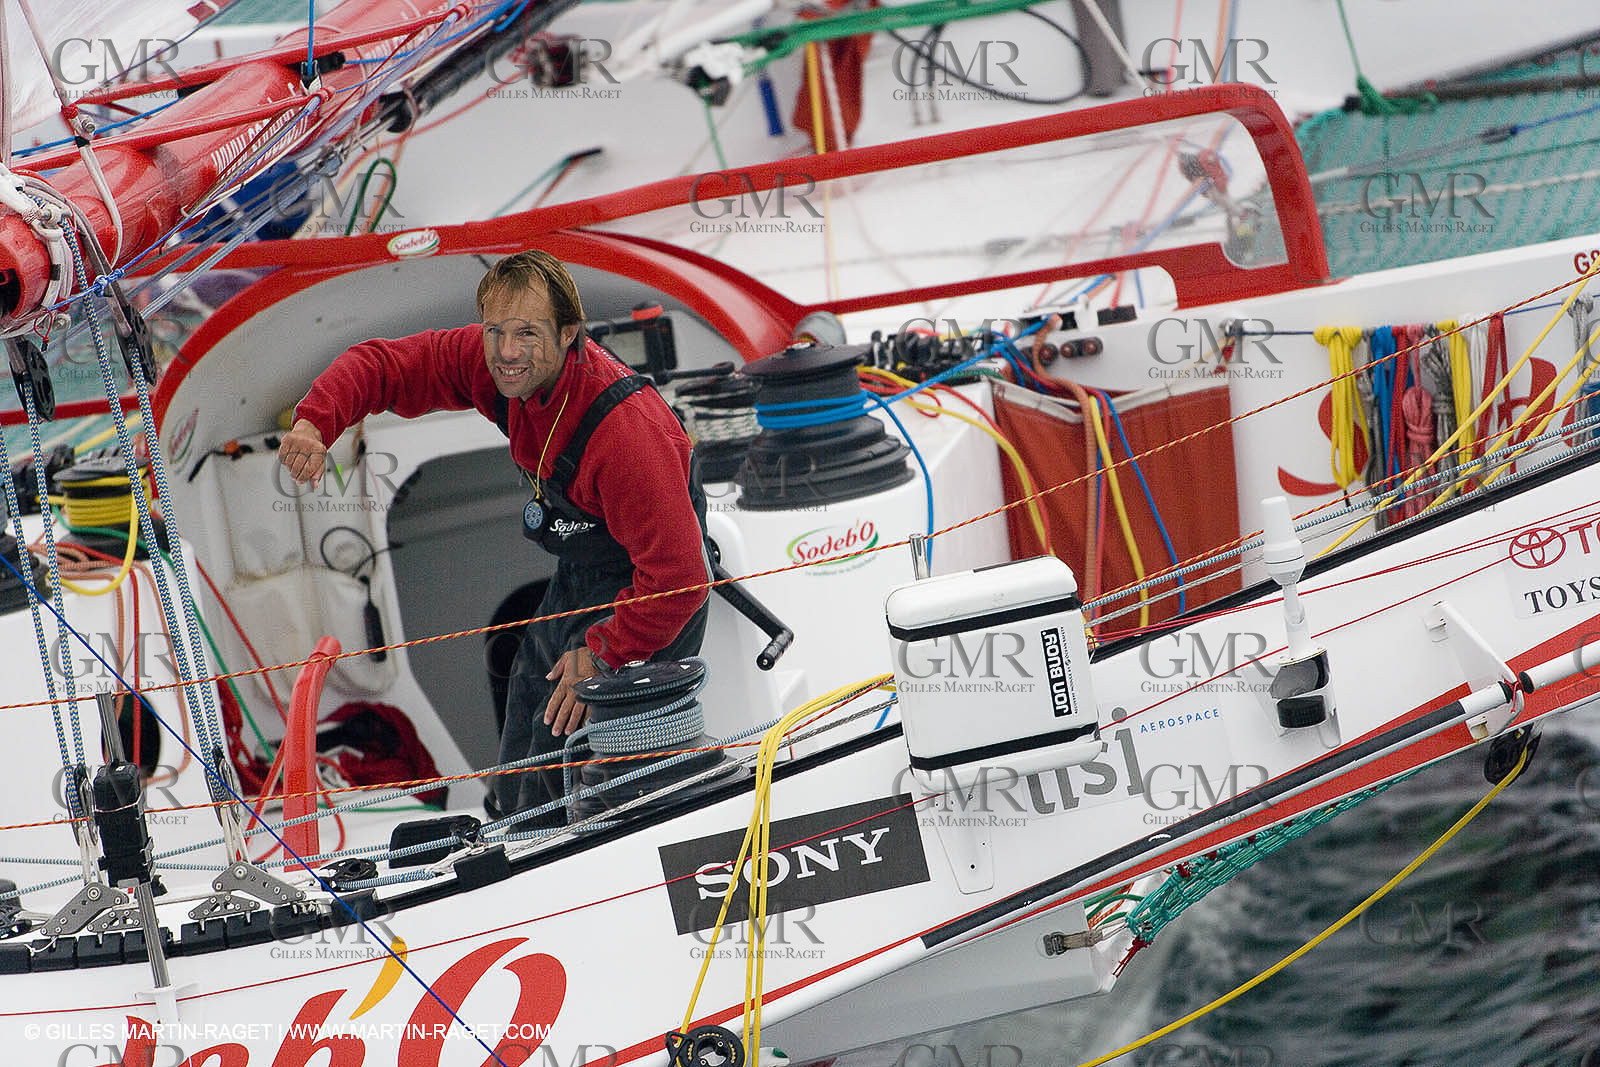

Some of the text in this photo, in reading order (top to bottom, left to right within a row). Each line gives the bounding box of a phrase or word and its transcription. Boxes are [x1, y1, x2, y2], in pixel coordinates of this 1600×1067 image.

[792, 518, 874, 565] Sodeb'O
[1042, 632, 1069, 714] JON BUOY
[1140, 708, 1220, 733] AEROSPACE
[694, 826, 890, 901] SONY
